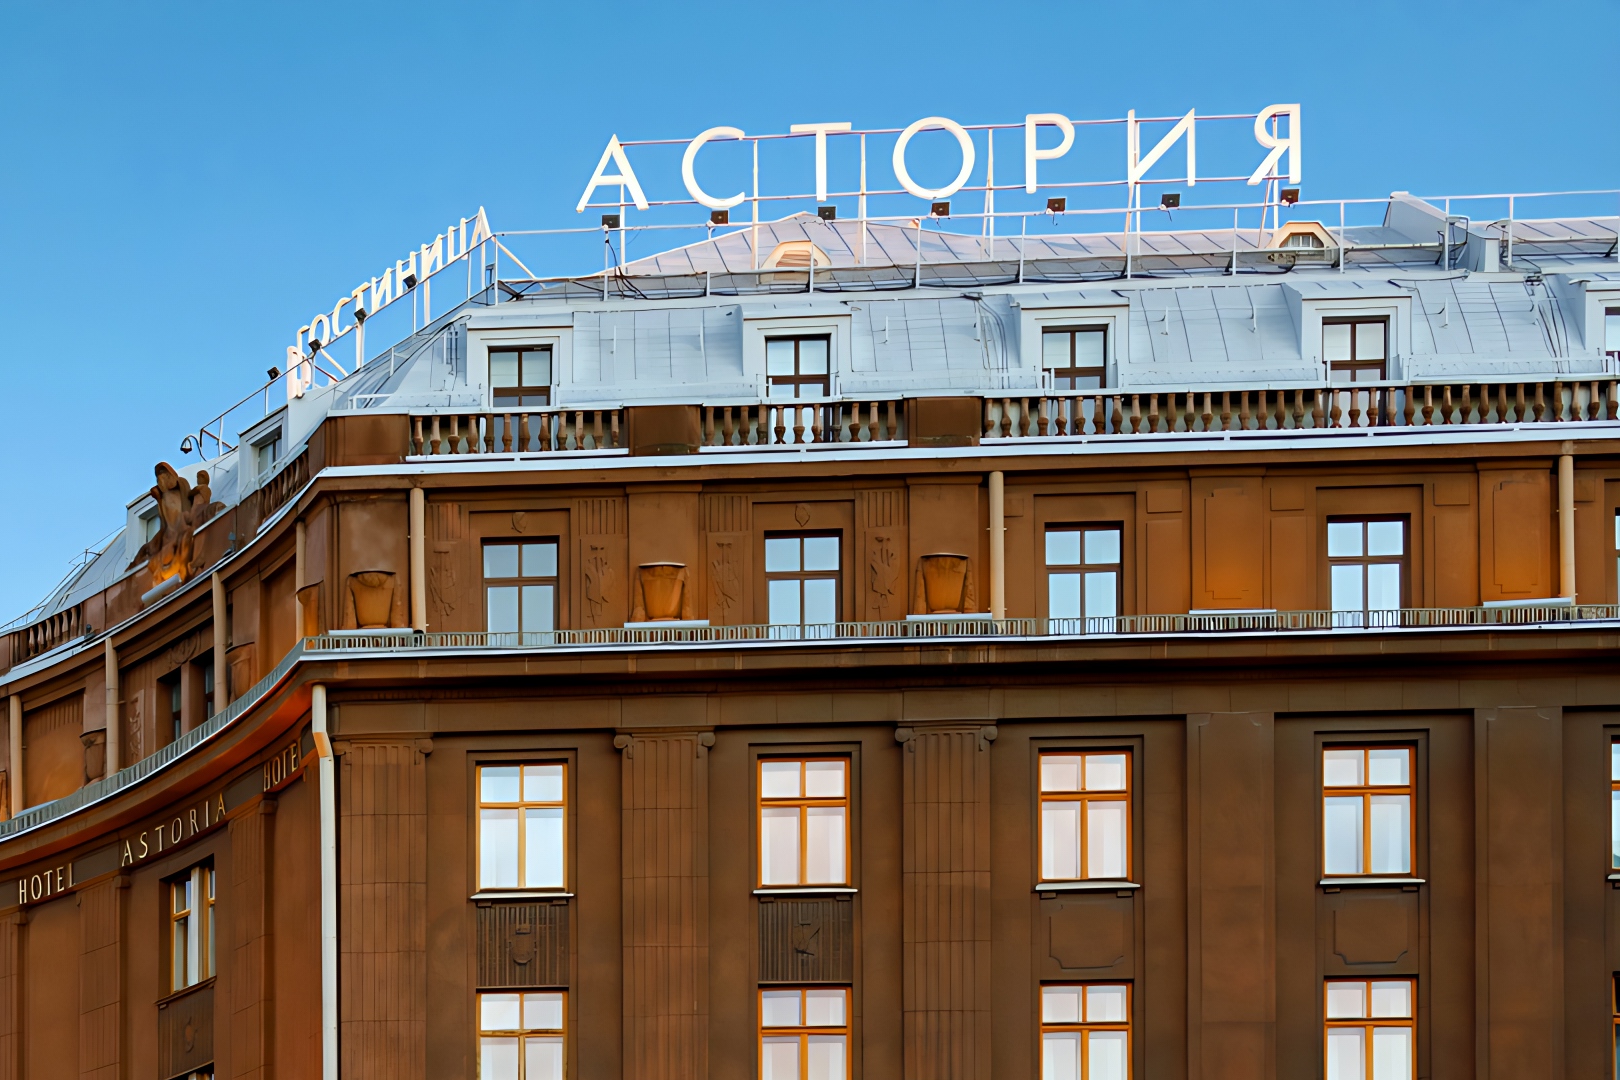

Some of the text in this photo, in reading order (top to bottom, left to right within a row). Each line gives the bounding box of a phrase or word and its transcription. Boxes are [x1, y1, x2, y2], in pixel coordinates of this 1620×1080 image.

[576, 103, 1301, 214] АСТОРИЯ
[19, 792, 226, 905] HOTEL ASTORIA
